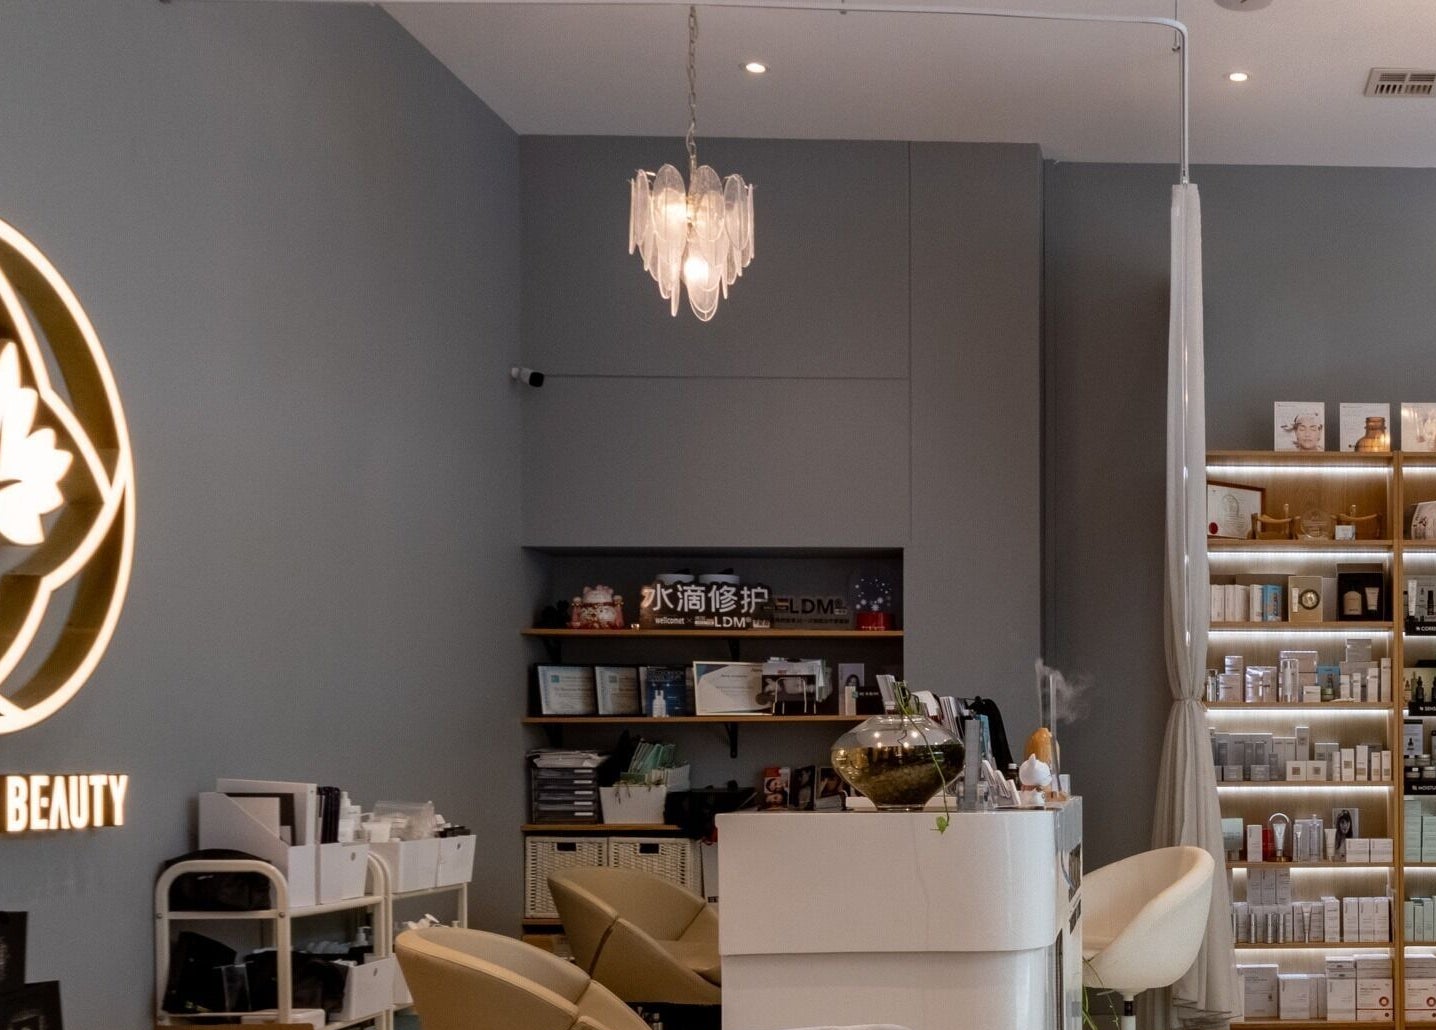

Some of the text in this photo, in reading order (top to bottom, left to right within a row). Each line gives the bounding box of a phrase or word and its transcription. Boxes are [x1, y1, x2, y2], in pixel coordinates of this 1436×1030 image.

[652, 583, 769, 613] 水滴修护
[5, 774, 128, 833] BEAUTY
